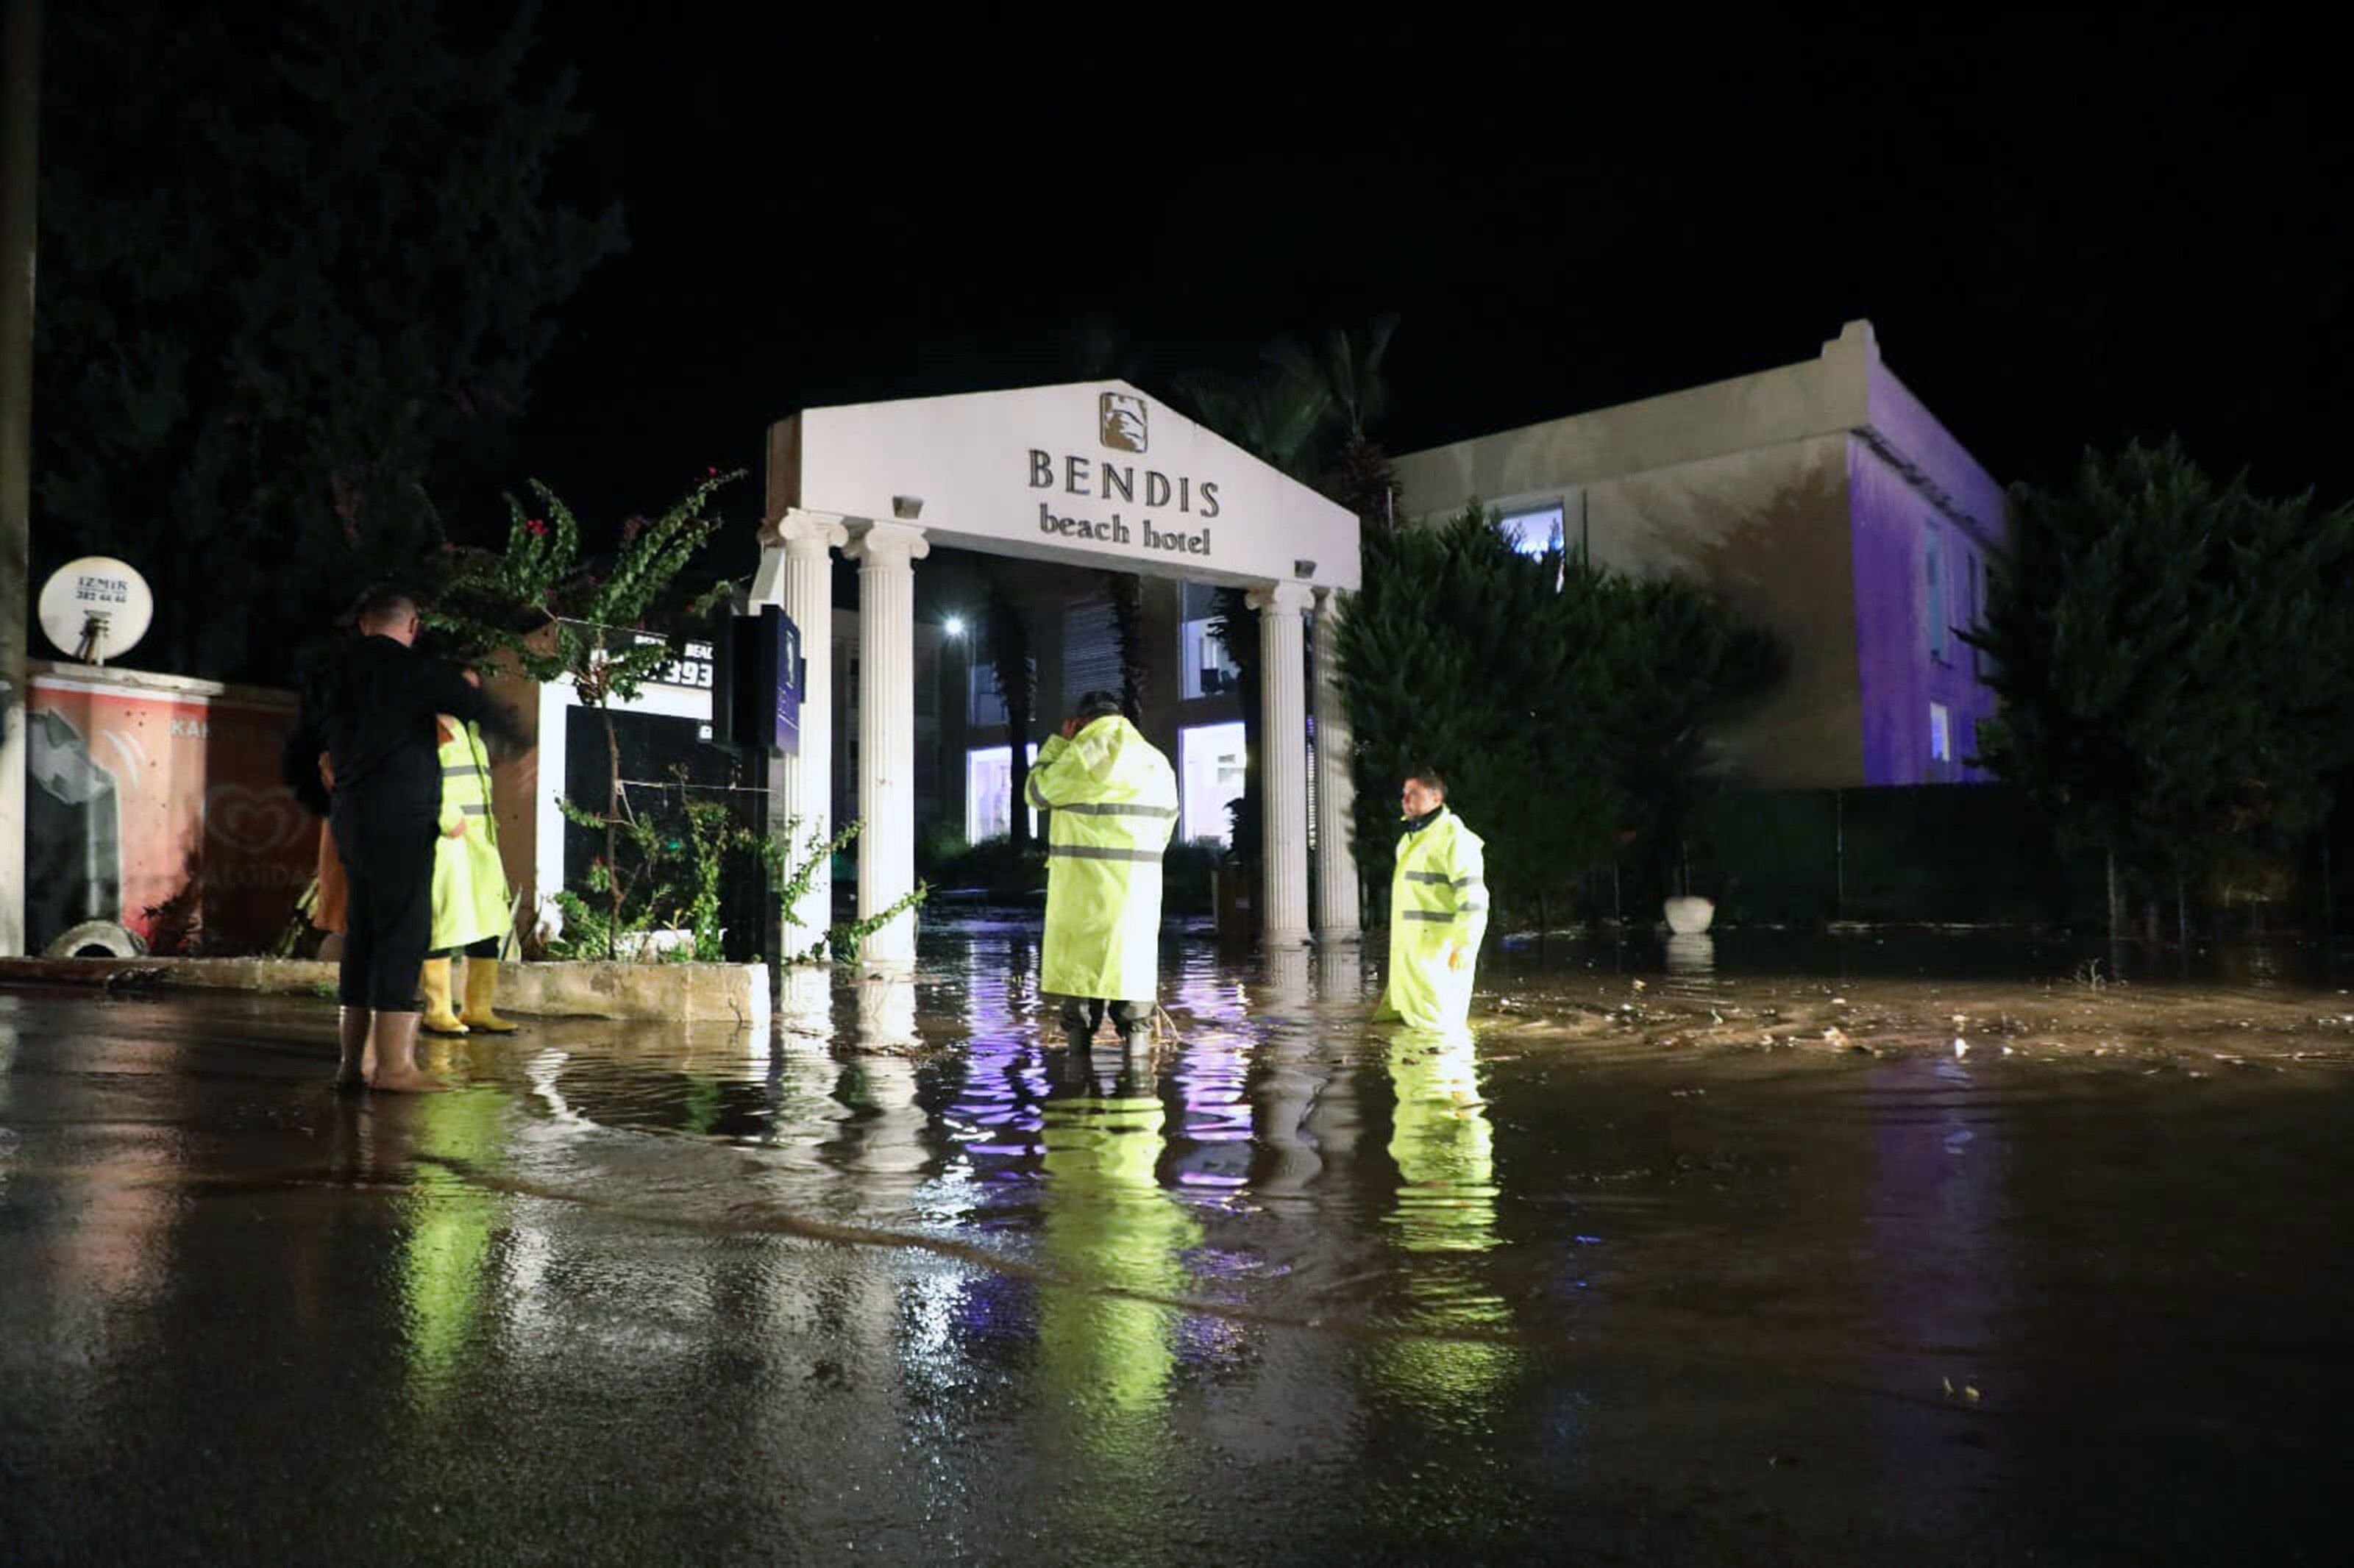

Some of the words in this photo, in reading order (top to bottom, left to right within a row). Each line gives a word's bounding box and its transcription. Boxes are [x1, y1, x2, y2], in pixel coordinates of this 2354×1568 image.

[1028, 449, 1220, 518] BENDIS
[1039, 503, 1130, 544] beach
[1142, 519, 1211, 555] hotel
